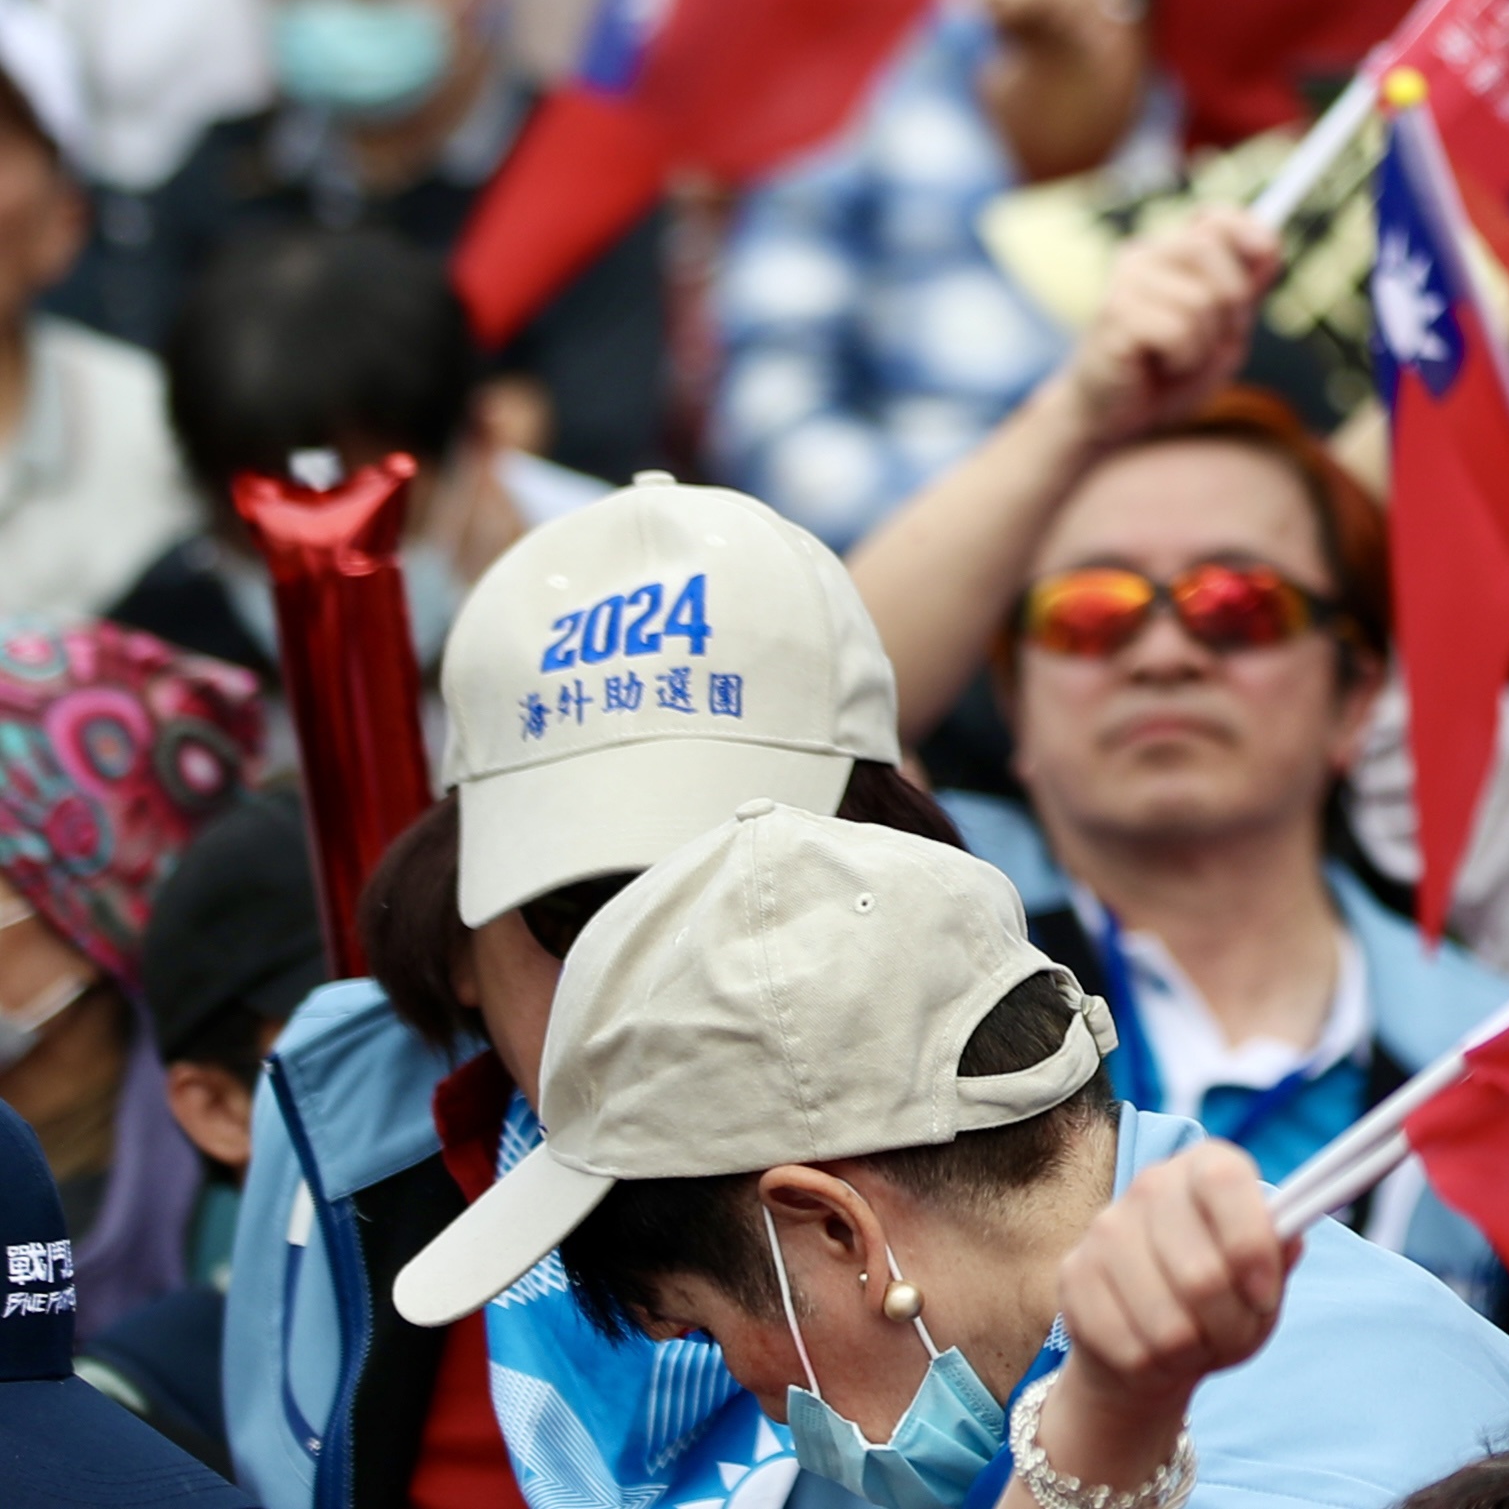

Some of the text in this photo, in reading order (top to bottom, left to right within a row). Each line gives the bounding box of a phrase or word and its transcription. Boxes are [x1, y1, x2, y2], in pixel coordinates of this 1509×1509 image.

[540, 573, 712, 674] 2024
[517, 664, 744, 743] 海外助選團
